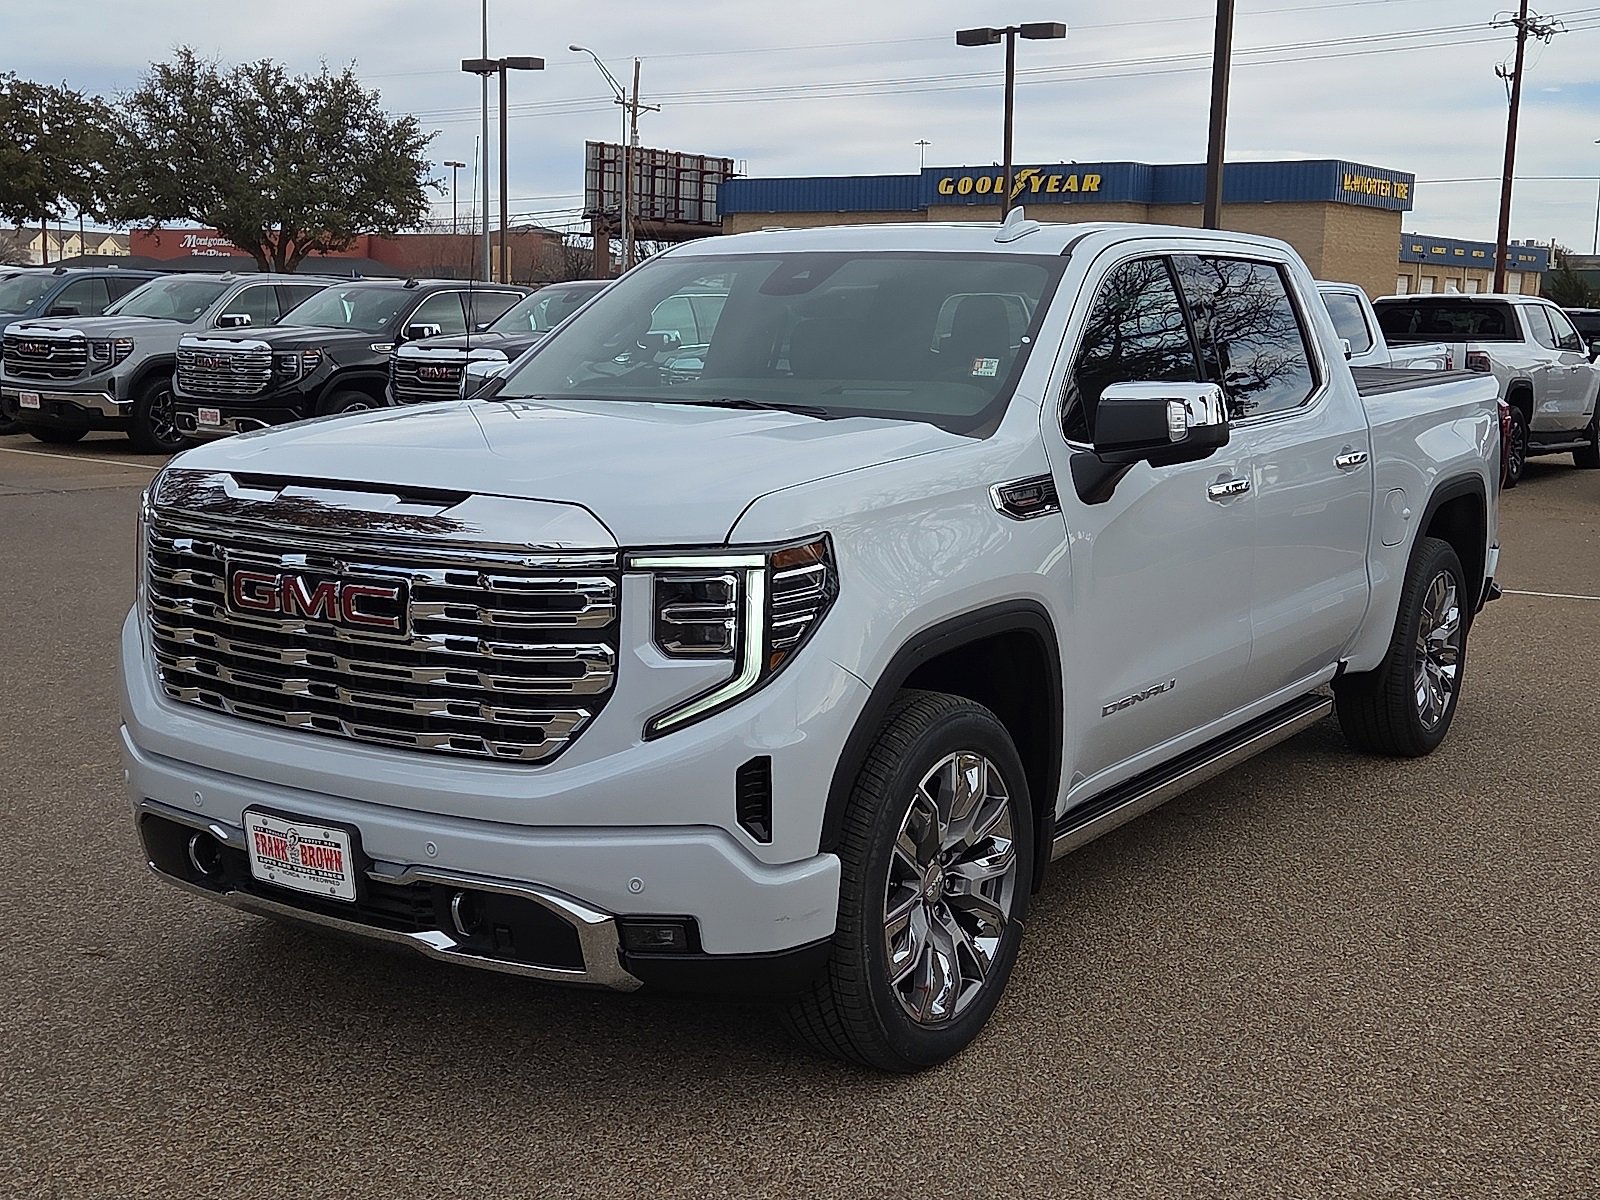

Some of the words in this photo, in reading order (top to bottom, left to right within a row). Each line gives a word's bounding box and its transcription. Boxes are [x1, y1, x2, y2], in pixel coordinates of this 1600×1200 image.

[1393, 183, 1409, 199] TIRE
[234, 570, 400, 630] GMC
[1101, 677, 1177, 718] DENALI
[254, 832, 289, 862] FRANK
[300, 844, 344, 873] BROWN
[318, 871, 343, 880] RANCH
